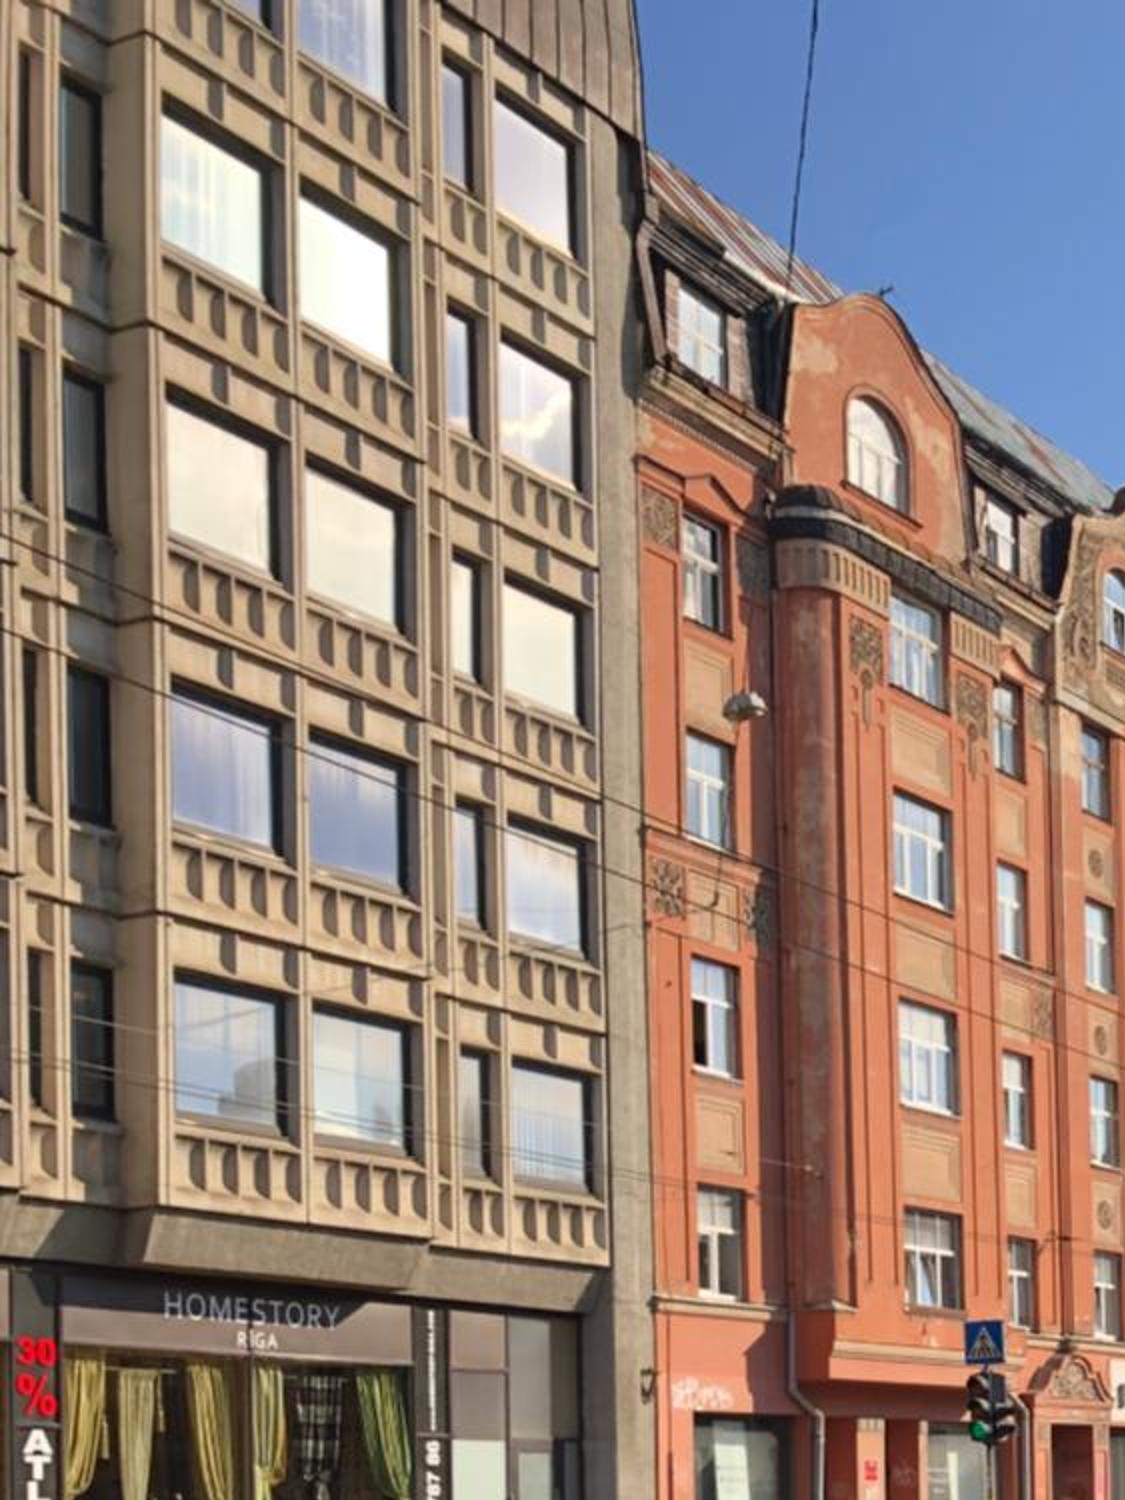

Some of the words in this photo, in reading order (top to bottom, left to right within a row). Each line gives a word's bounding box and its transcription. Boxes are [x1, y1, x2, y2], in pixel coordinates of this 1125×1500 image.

[163, 1291, 340, 1331] HOMESTORY
[15, 1335, 57, 1366] 30
[15, 1372, 57, 1416] %
